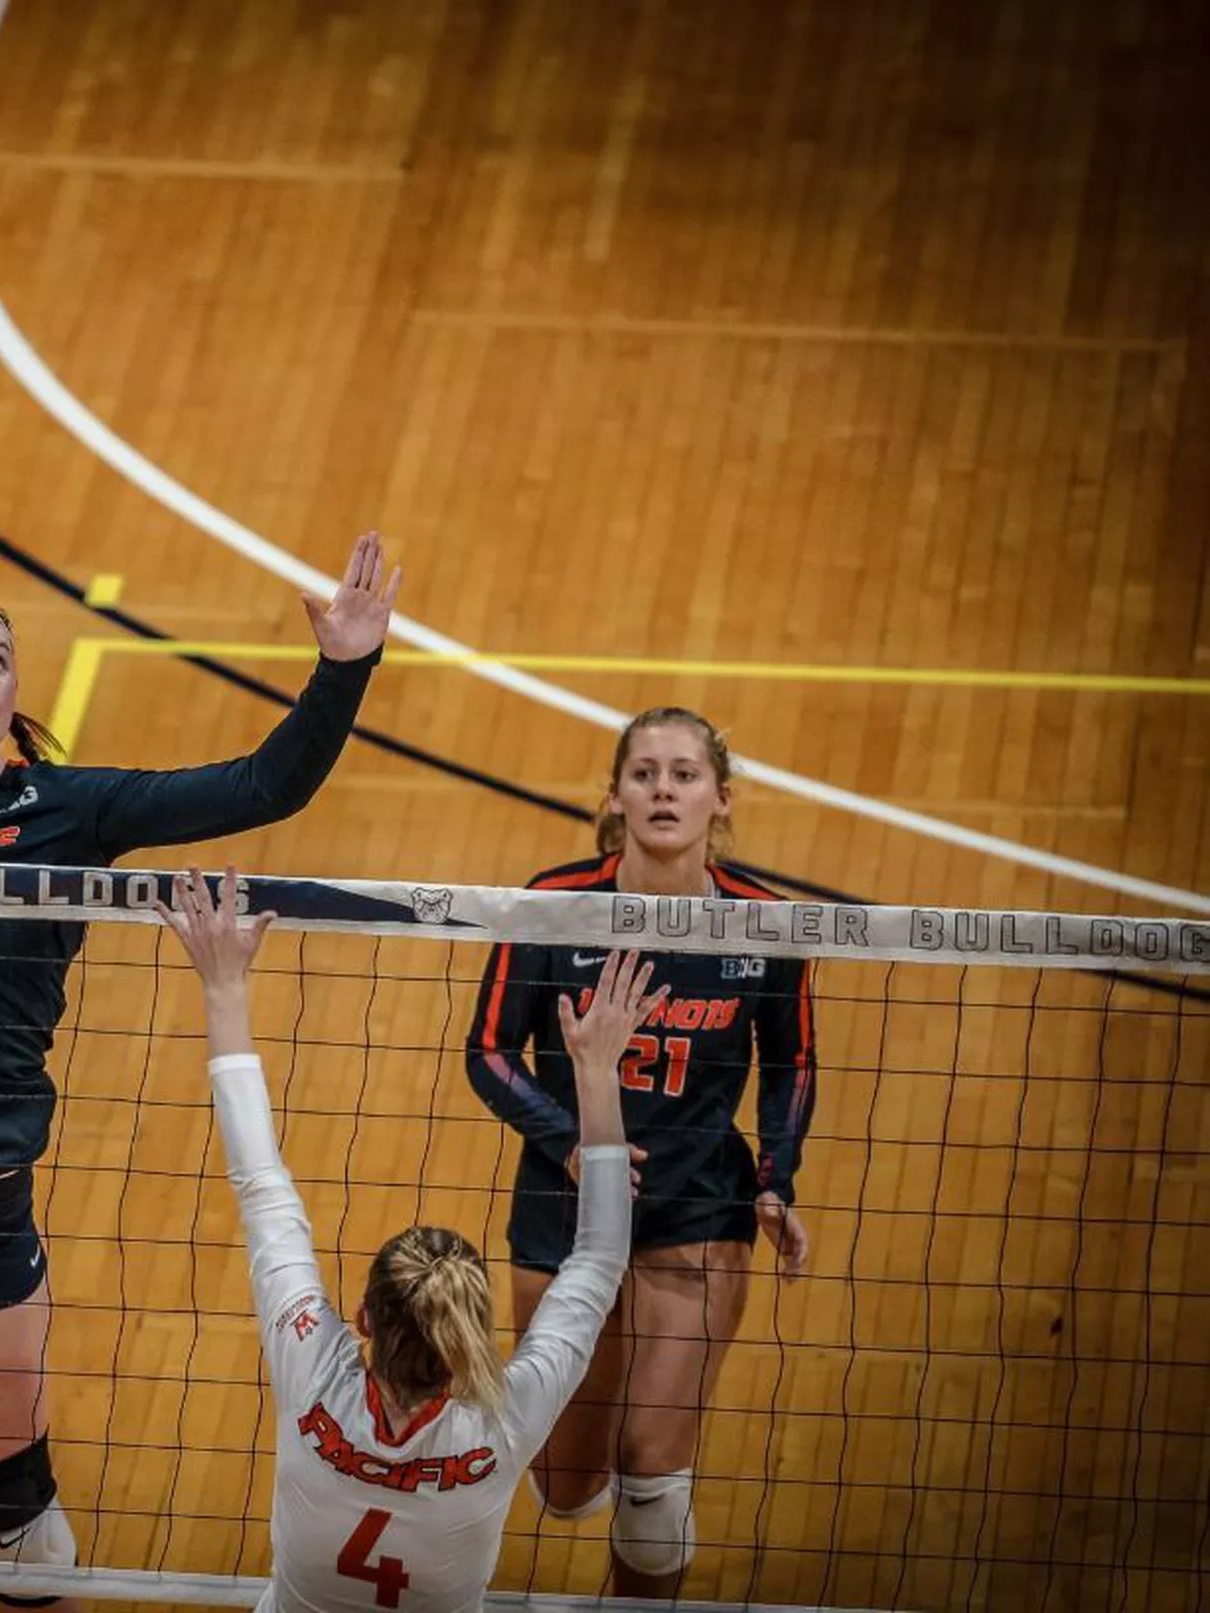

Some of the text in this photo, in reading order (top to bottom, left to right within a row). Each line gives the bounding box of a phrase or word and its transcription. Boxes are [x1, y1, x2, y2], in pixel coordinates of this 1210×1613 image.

[610, 897, 870, 948] BUTLER
[620, 1034, 691, 1097] 21
[297, 1401, 497, 1493] PACIFIC
[336, 1507, 410, 1609] 4
